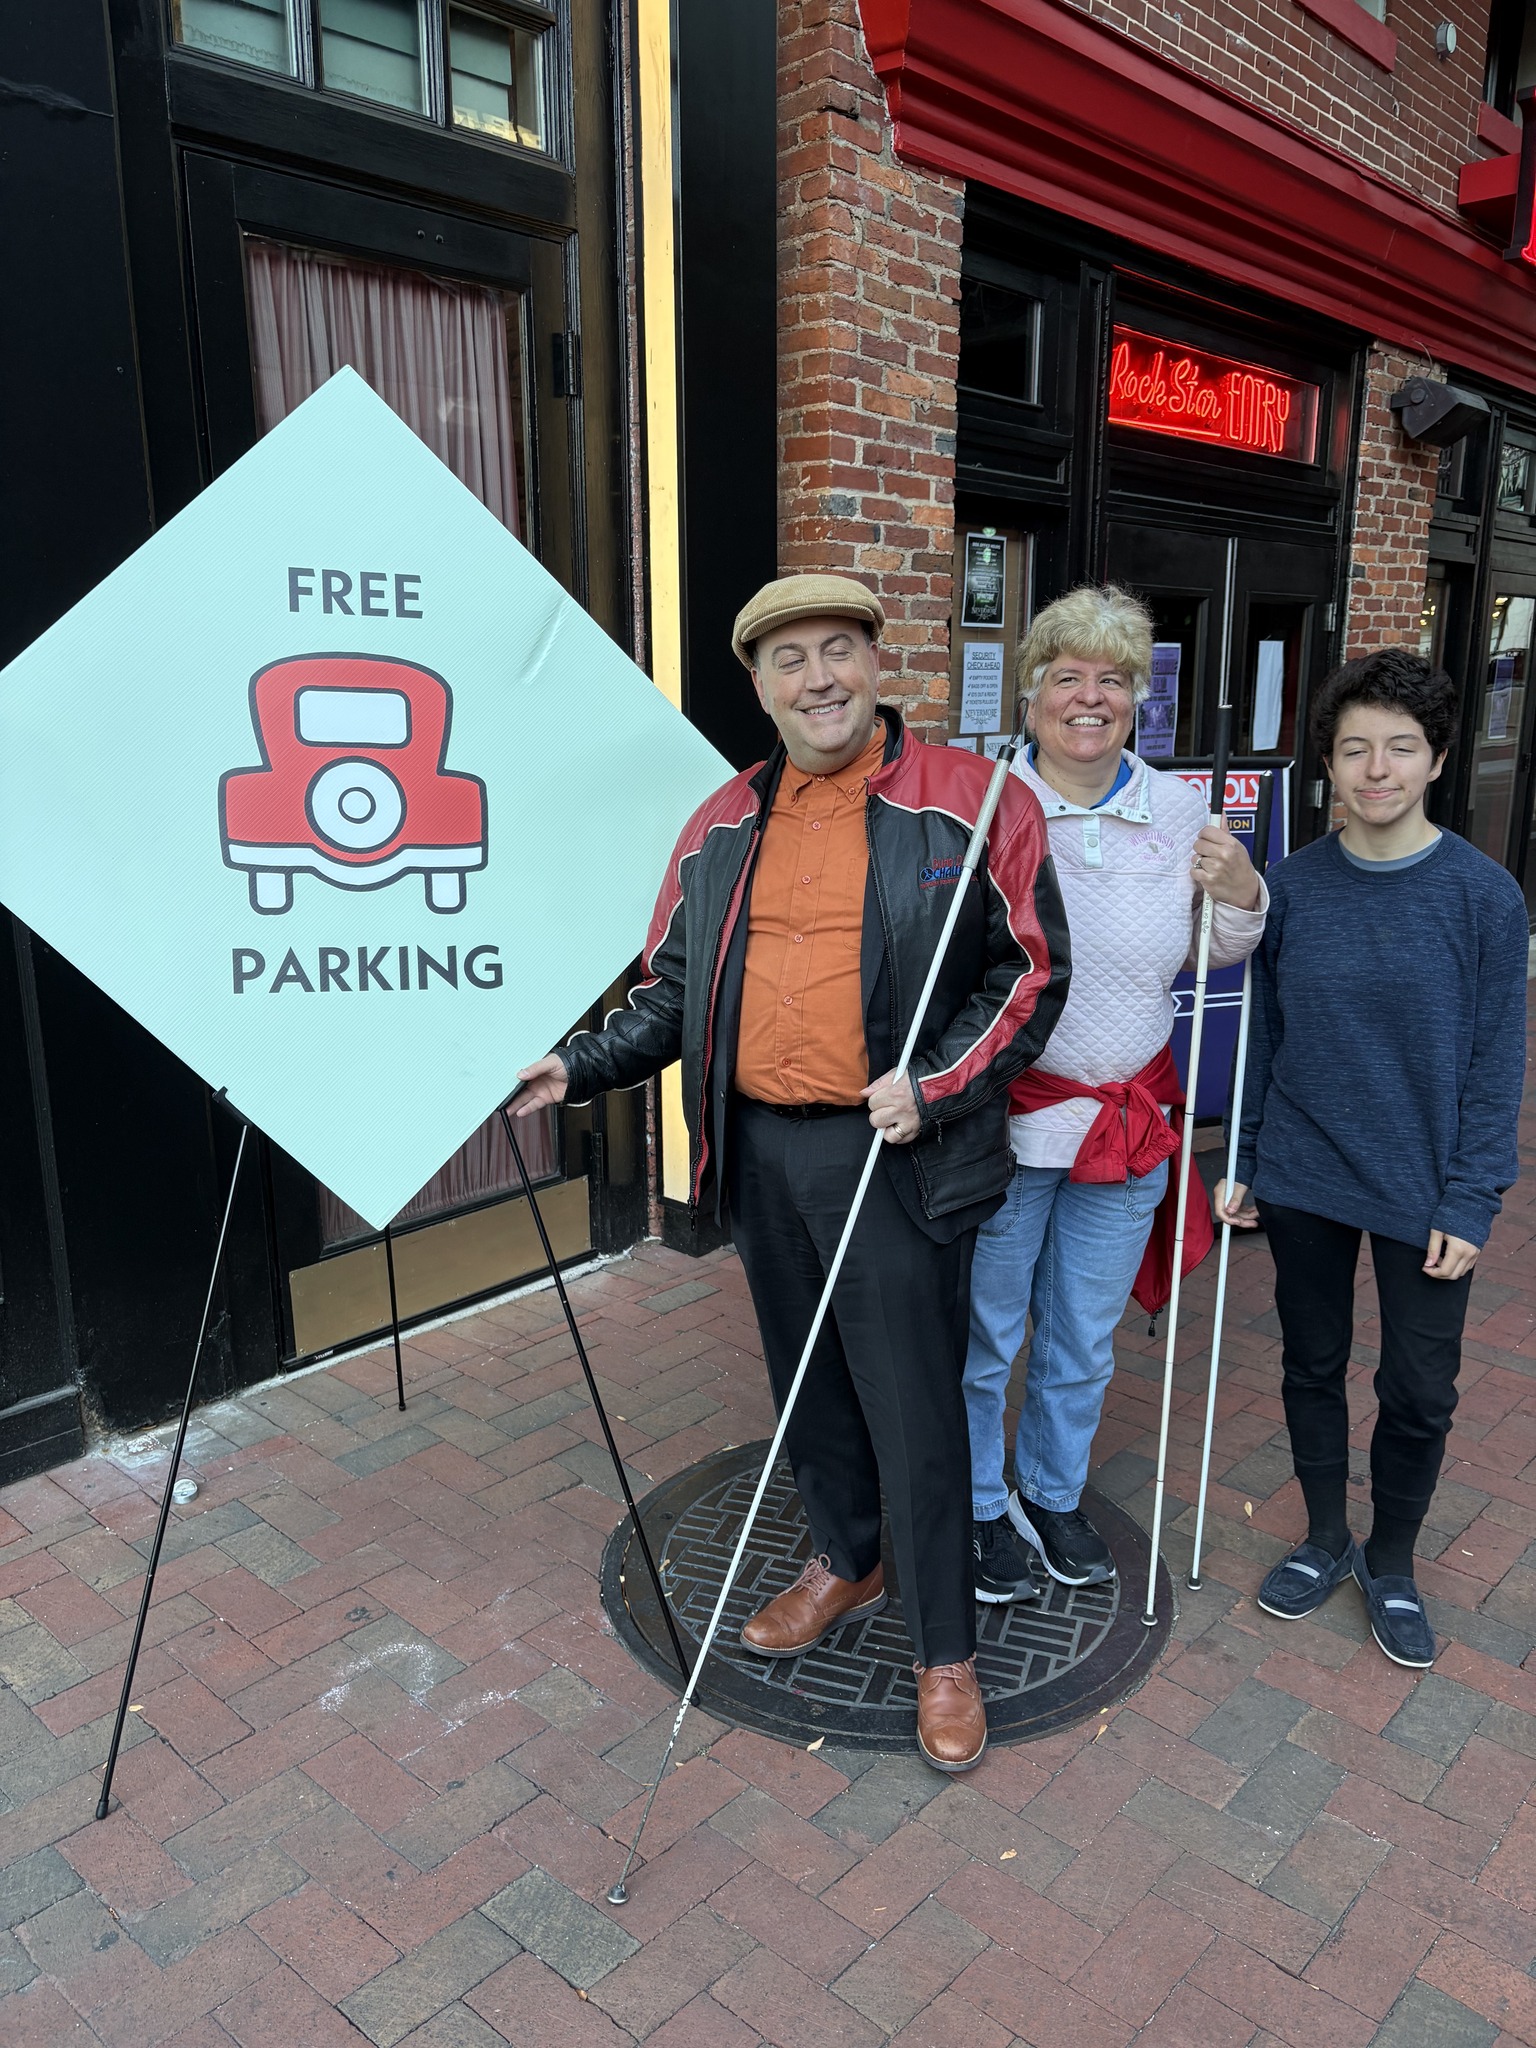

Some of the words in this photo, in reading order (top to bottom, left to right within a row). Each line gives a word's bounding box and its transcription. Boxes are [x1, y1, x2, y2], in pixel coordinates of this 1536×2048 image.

[1110, 342, 1166, 406] Rock
[1168, 358, 1222, 419] Star
[288, 567, 424, 619] FREE
[966, 661, 984, 670] CHECK
[984, 661, 1001, 670] AHEAD
[972, 652, 996, 660] SECURITY
[965, 708, 998, 719] NEVERMORE
[1129, 829, 1176, 850] WISCONSIN
[231, 943, 504, 995] PARKING
